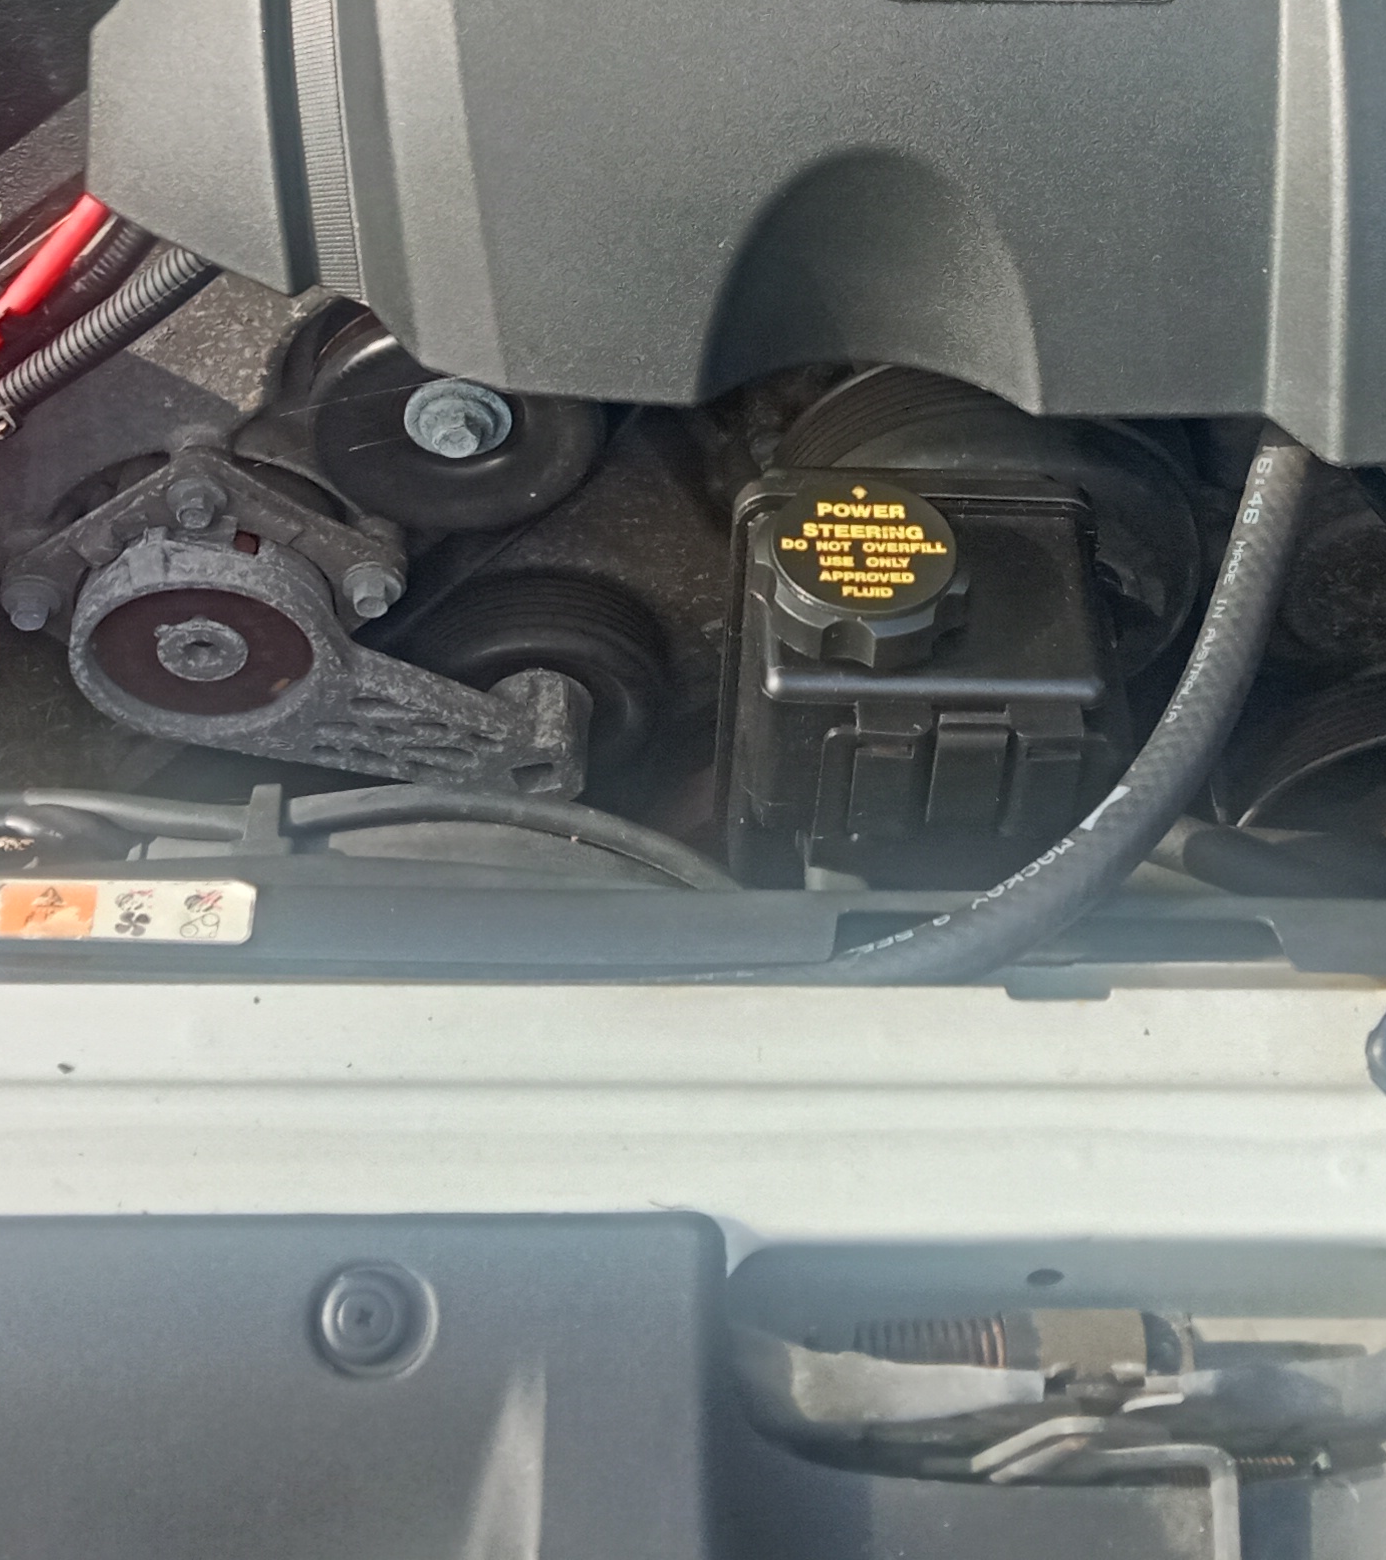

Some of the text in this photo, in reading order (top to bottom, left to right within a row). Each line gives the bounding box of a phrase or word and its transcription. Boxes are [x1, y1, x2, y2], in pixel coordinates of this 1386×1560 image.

[817, 502, 905, 519] POWER
[803, 522, 924, 540] STEERING
[781, 538, 947, 554] DO NOT OVERFILL
[819, 555, 911, 568] USE ONLY
[1222, 540, 1248, 585] MADE
[819, 570, 915, 584] APPROVED
[842, 585, 893, 598] FLUID
[1212, 598, 1229, 619] IN
[1164, 628, 1217, 724] AUSTRALIA
[971, 838, 1077, 910] MACKAY
